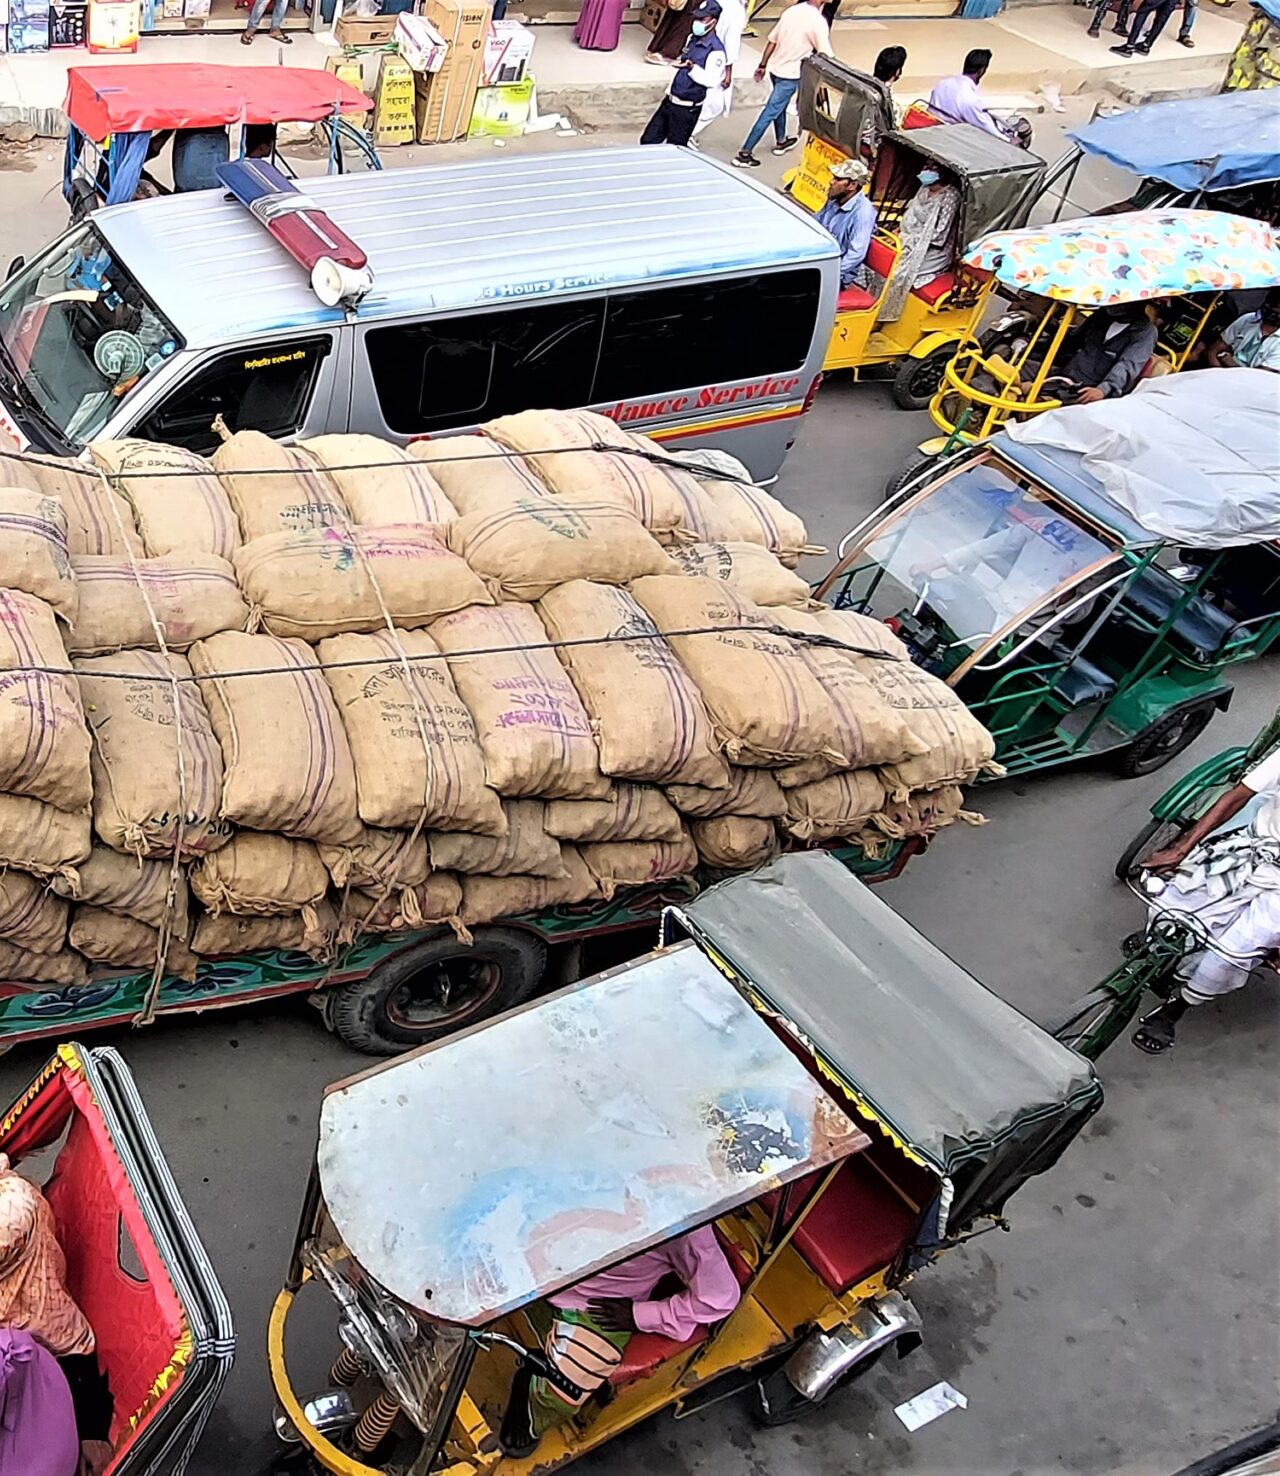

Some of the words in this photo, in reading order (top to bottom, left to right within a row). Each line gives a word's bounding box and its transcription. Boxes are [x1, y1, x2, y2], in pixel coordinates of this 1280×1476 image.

[501, 281, 551, 297] Hours
[600, 396, 688, 422] ulance
[695, 376, 799, 408] Service
